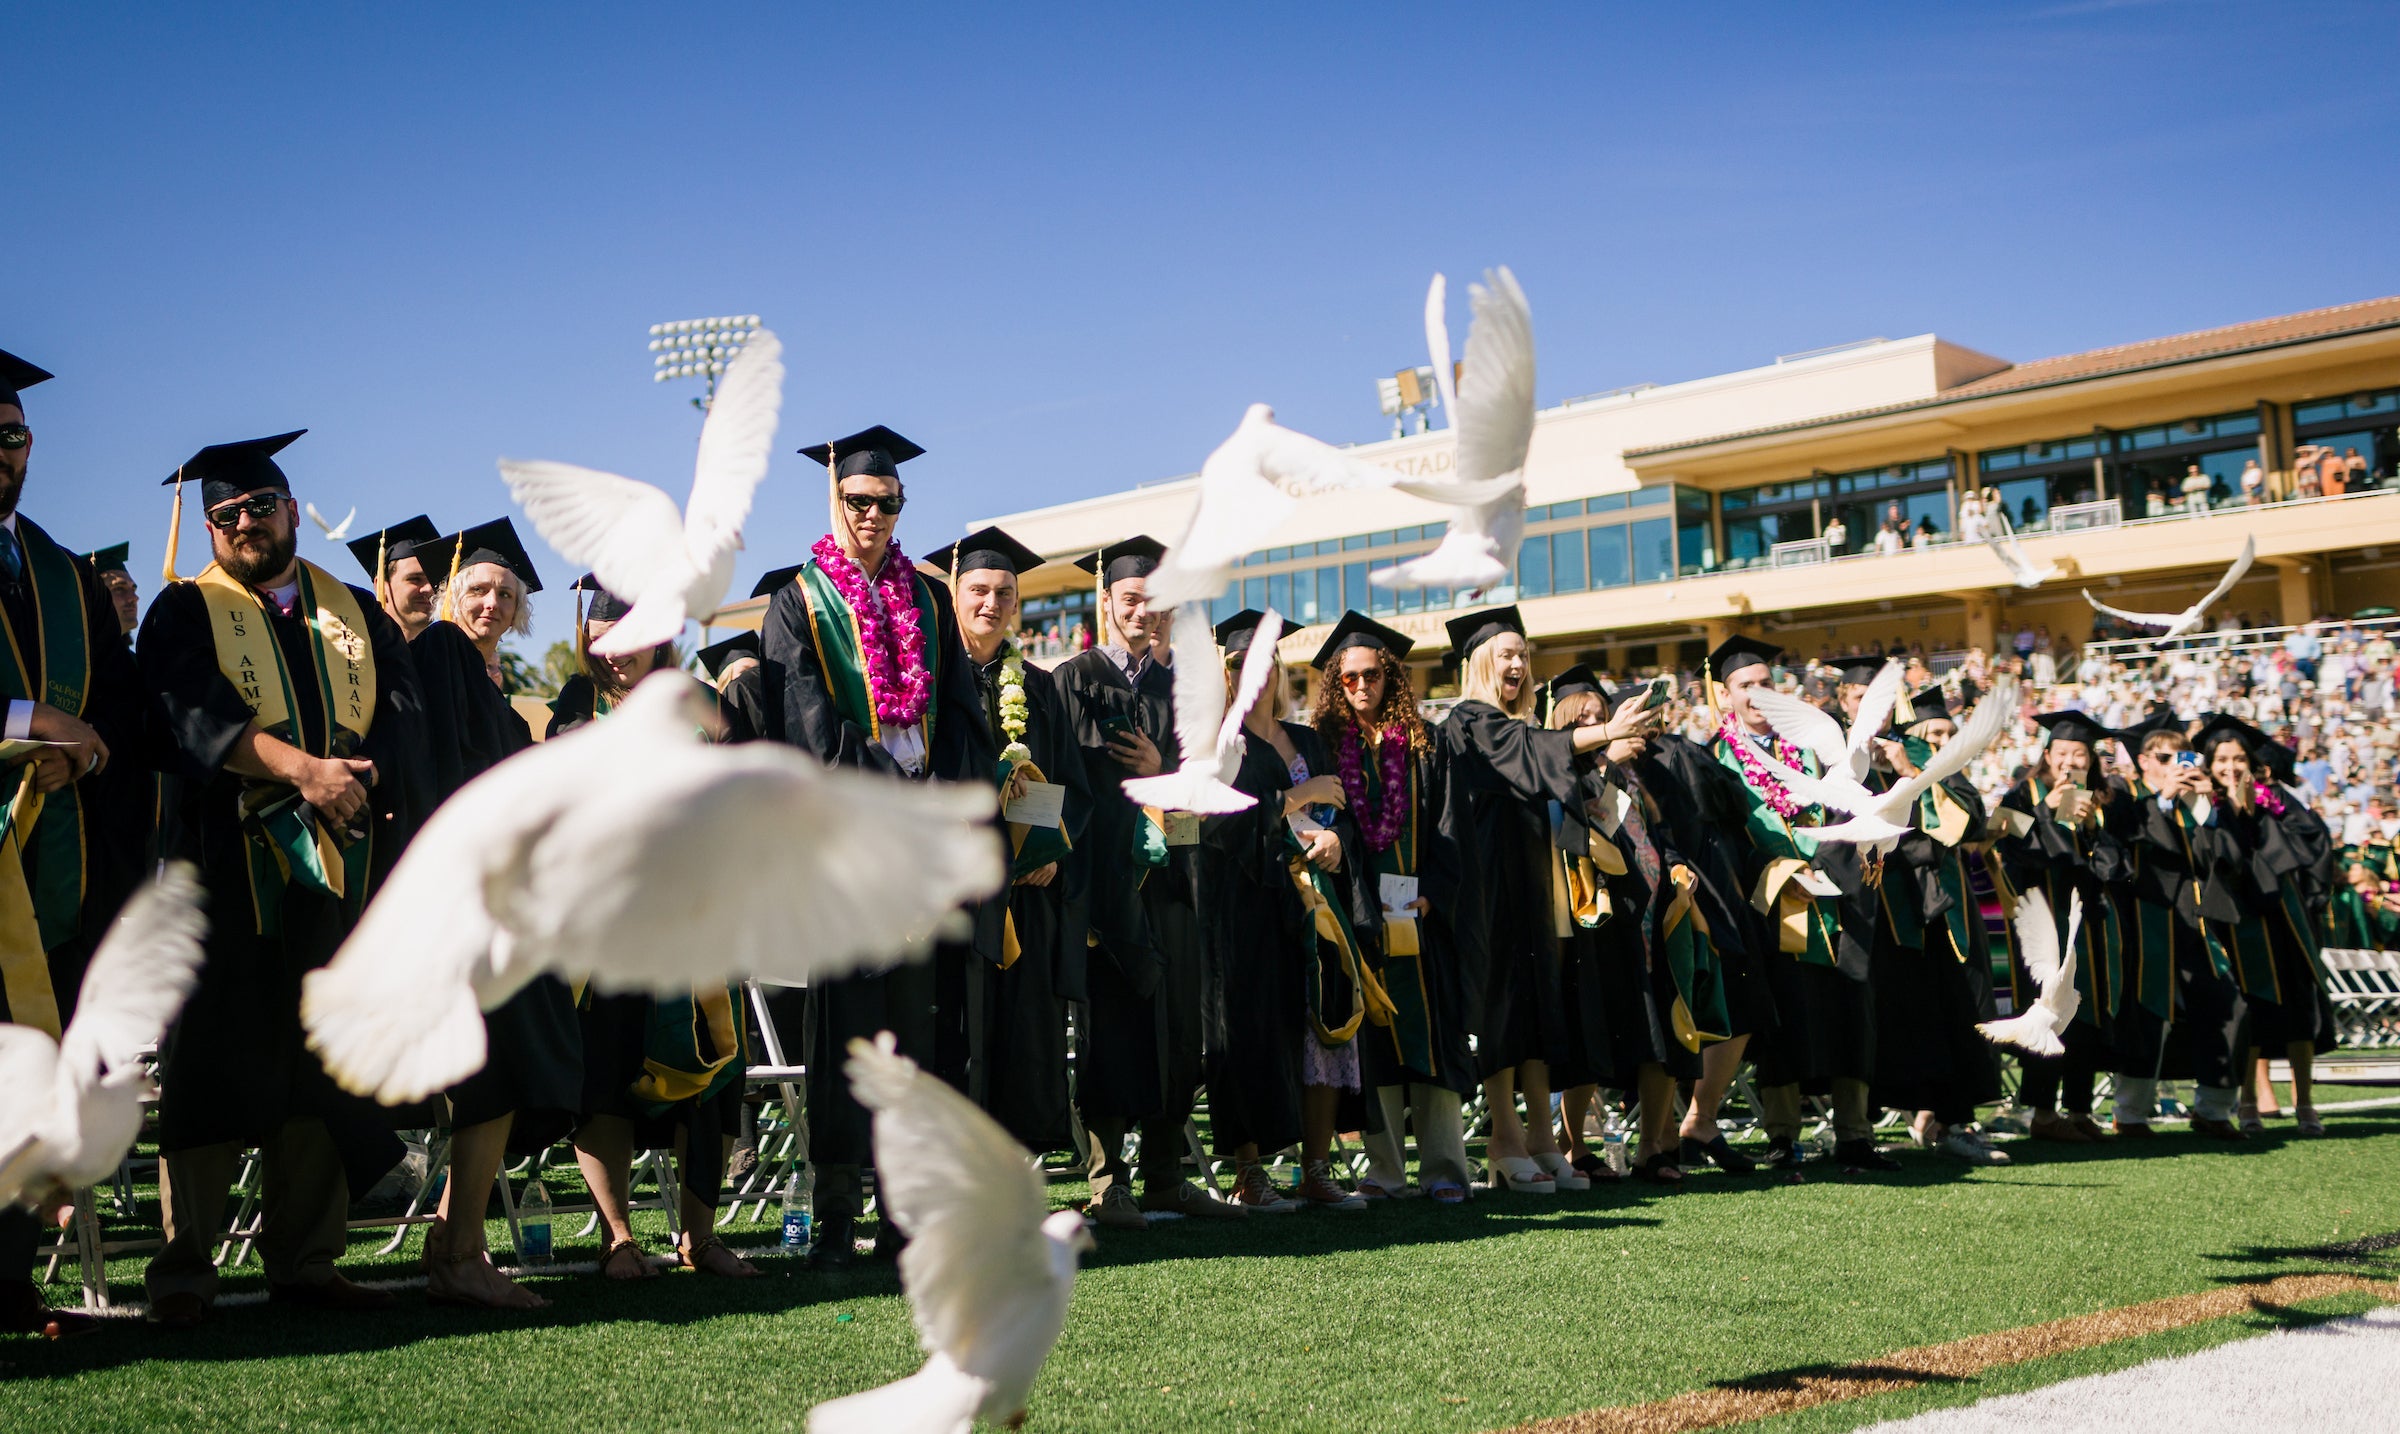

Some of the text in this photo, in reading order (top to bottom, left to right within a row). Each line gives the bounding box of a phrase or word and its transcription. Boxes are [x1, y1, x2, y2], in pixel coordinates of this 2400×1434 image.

[1393, 450, 1458, 477] STADI
[229, 611, 262, 716] US ARMY
[338, 615, 362, 719] VETERAN
[54, 694, 76, 713] 2022
